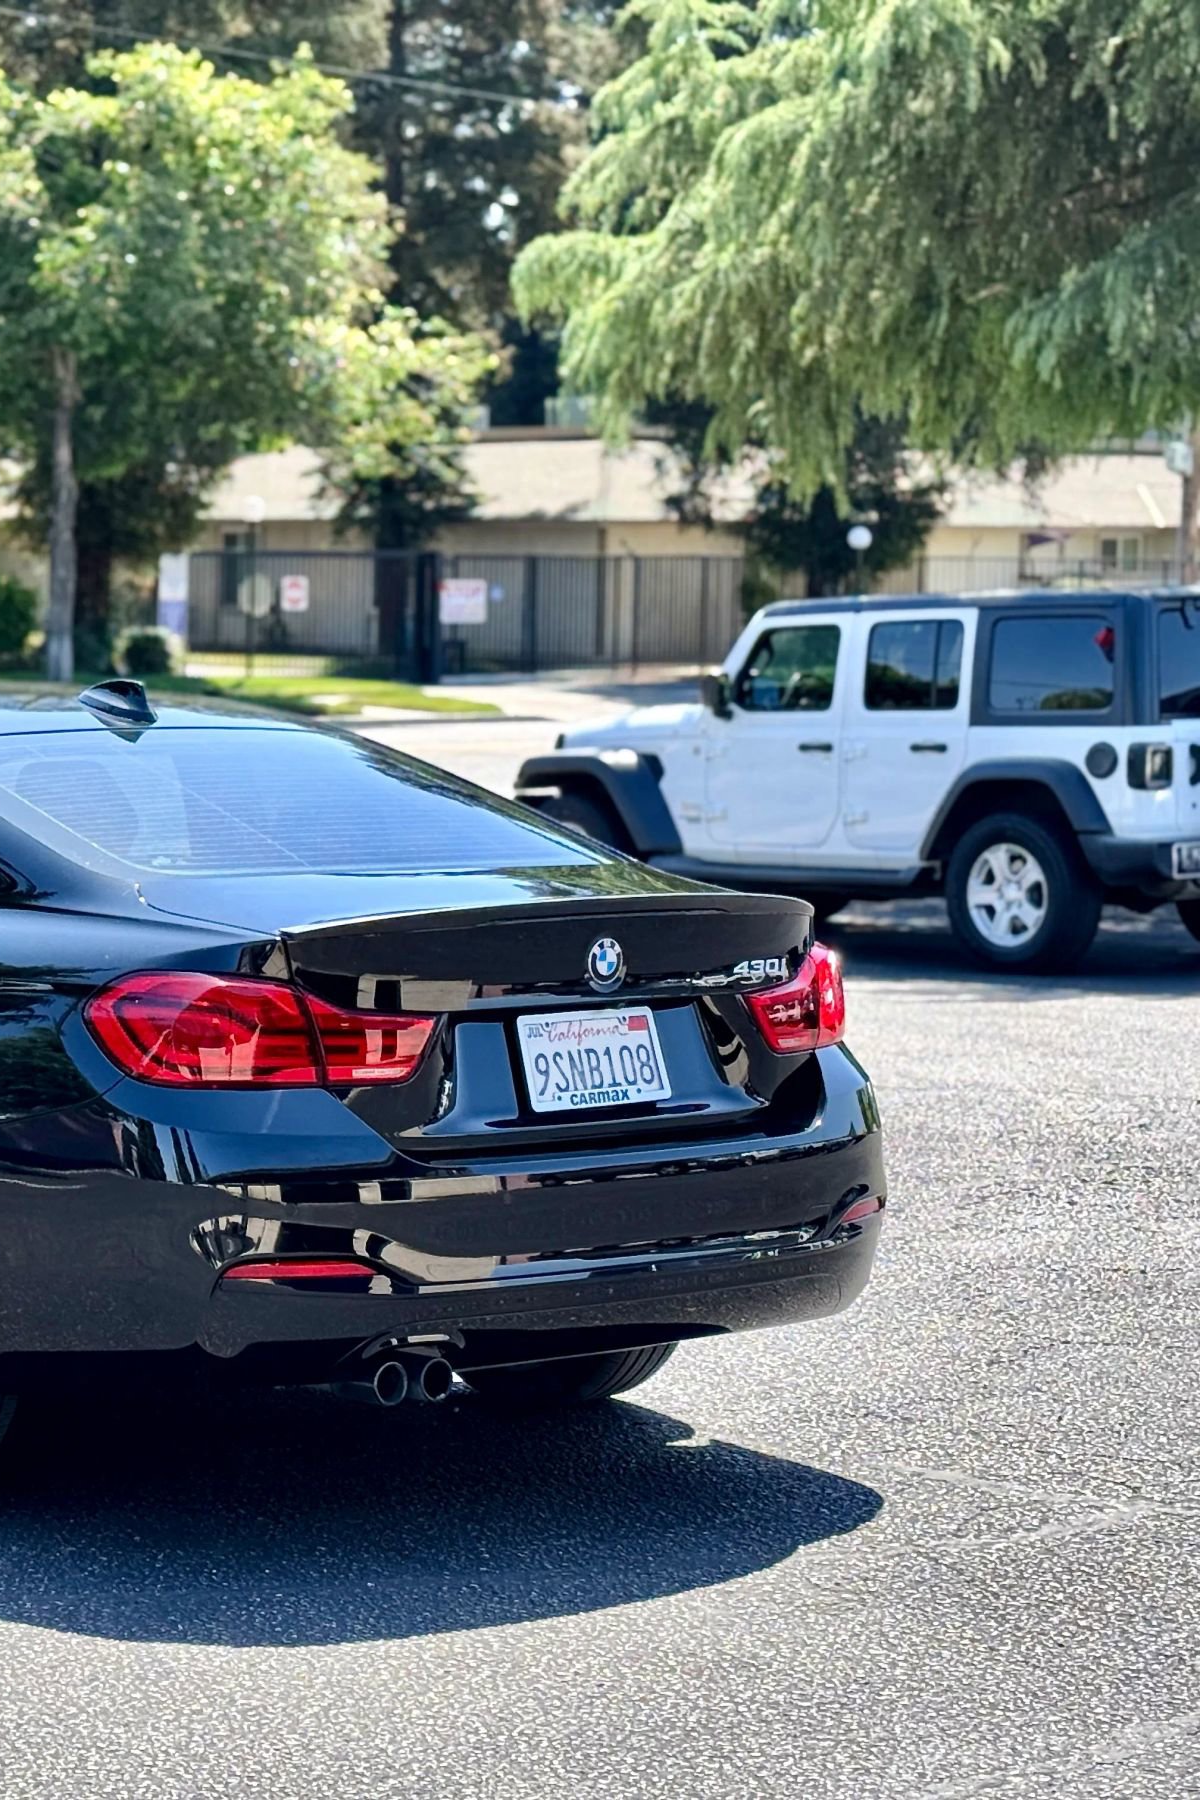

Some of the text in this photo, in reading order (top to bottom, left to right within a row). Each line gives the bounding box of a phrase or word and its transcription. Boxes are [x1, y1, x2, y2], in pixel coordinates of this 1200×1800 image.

[733, 957, 787, 977] 430i
[527, 1026, 543, 1038] JUL
[547, 1019, 629, 1046] California
[534, 1044, 654, 1096] 9SNB108
